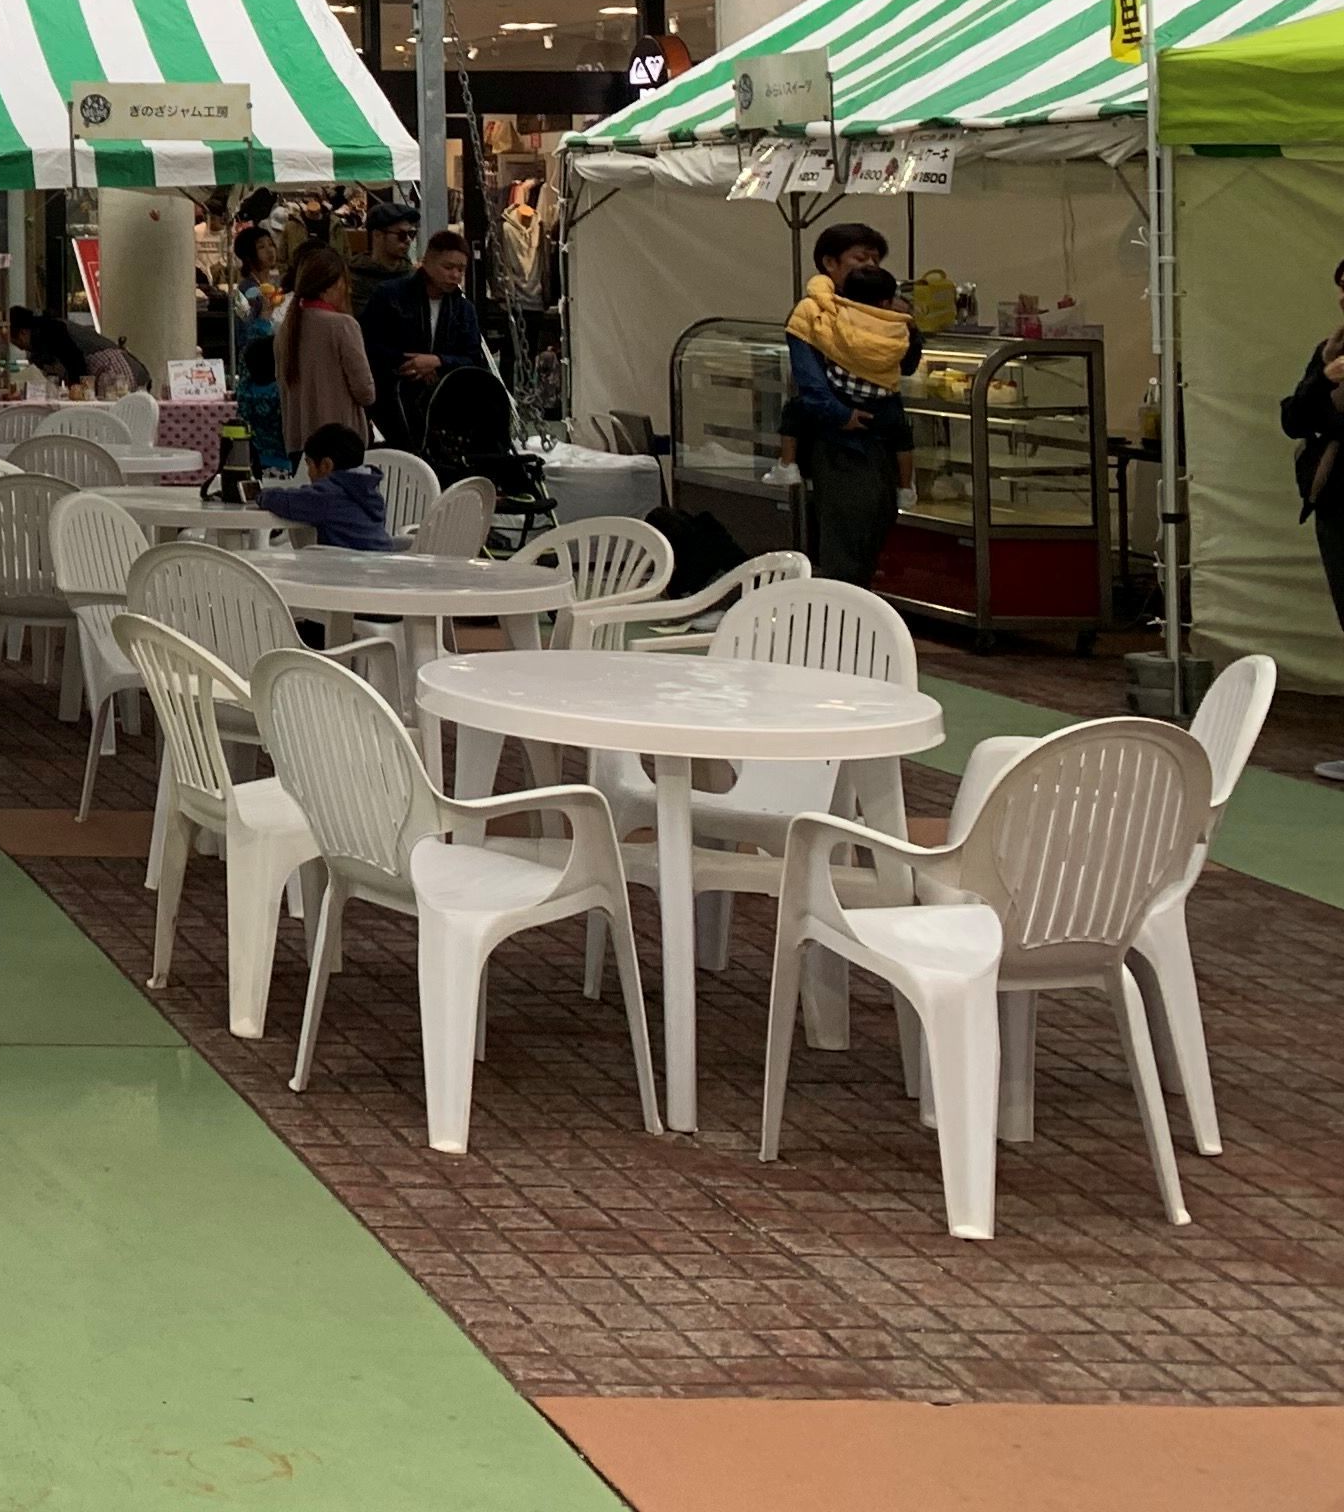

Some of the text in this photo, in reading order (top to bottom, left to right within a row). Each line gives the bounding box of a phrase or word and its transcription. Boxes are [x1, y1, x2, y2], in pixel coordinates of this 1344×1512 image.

[128, 104, 229, 119] ぎのざジャム工房
